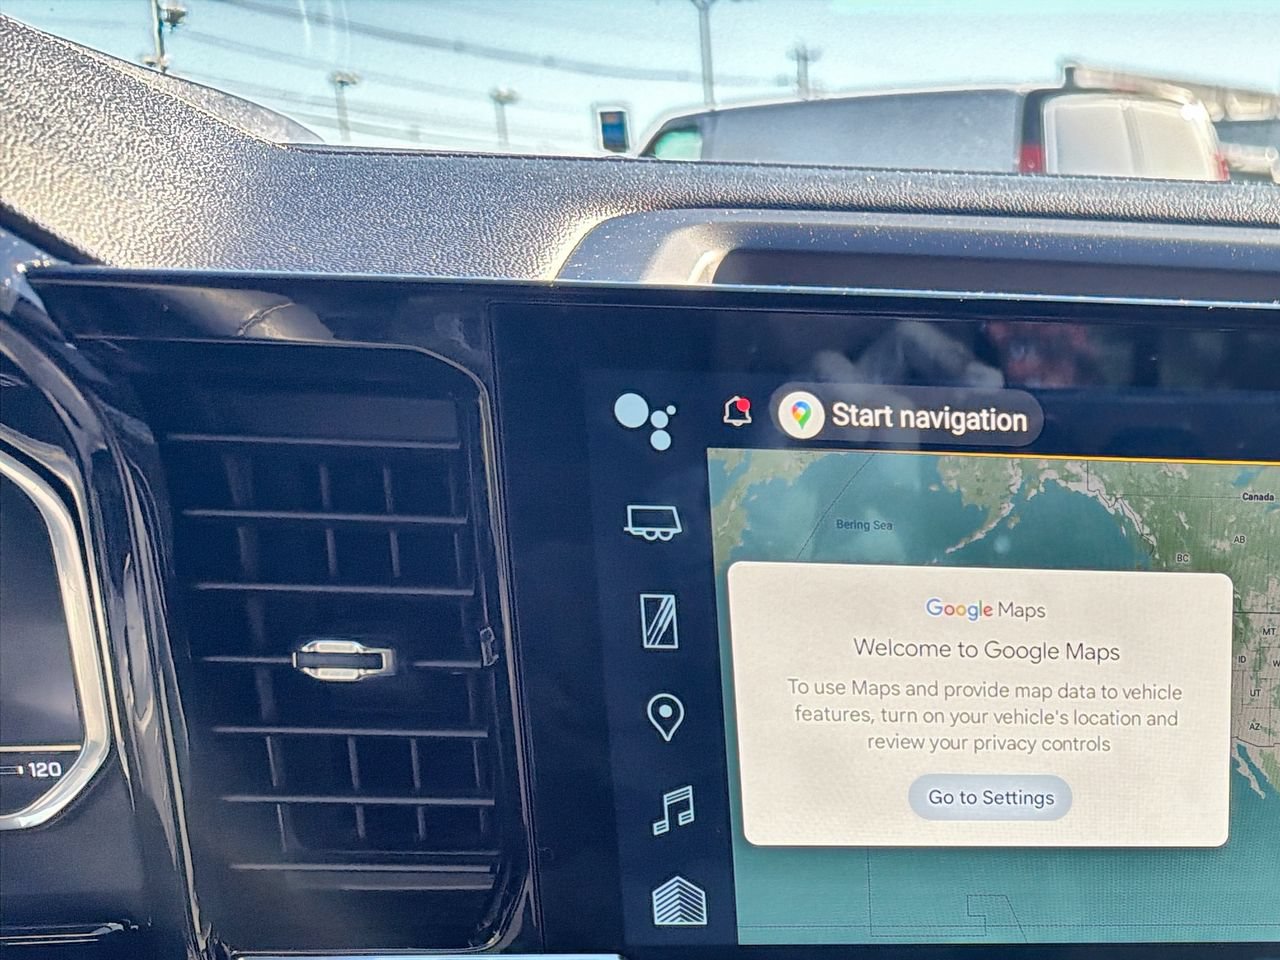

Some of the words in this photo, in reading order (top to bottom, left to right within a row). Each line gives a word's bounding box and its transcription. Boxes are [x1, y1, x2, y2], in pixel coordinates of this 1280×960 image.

[833, 403, 894, 428] Start
[900, 406, 1028, 436] navigation
[1242, 493, 1274, 501] Canada
[836, 518, 871, 532] Bering
[873, 520, 893, 531] Sea
[927, 598, 993, 622] Google
[998, 601, 1046, 620] Maps
[1263, 628, 1276, 636] MT
[854, 638, 954, 660] Welcome
[958, 641, 979, 660] to
[984, 640, 1060, 664] Google
[1066, 641, 1120, 663] Maps
[788, 679, 809, 696] To
[813, 683, 846, 697] use
[852, 680, 901, 701] Maps
[906, 681, 938, 699] and
[944, 681, 1010, 703] provide
[1015, 685, 1053, 703] map
[1058, 683, 1096, 700] data
[1101, 684, 1117, 700] to
[1122, 683, 1182, 701] vehicle
[795, 705, 875, 725] features,
[881, 708, 918, 725] turn
[923, 711, 946, 725] on
[950, 711, 989, 730] your
[994, 708, 1068, 727] vehicle's
[1074, 708, 1141, 727] location
[1146, 708, 1178, 726] and
[868, 734, 924, 752] review
[929, 737, 968, 755] your
[974, 734, 1037, 756] privacy
[1042, 734, 1111, 753] controls
[29, 762, 62, 778] 120
[929, 789, 955, 806] Go
[960, 790, 978, 806] to
[982, 788, 1055, 810] Settings
